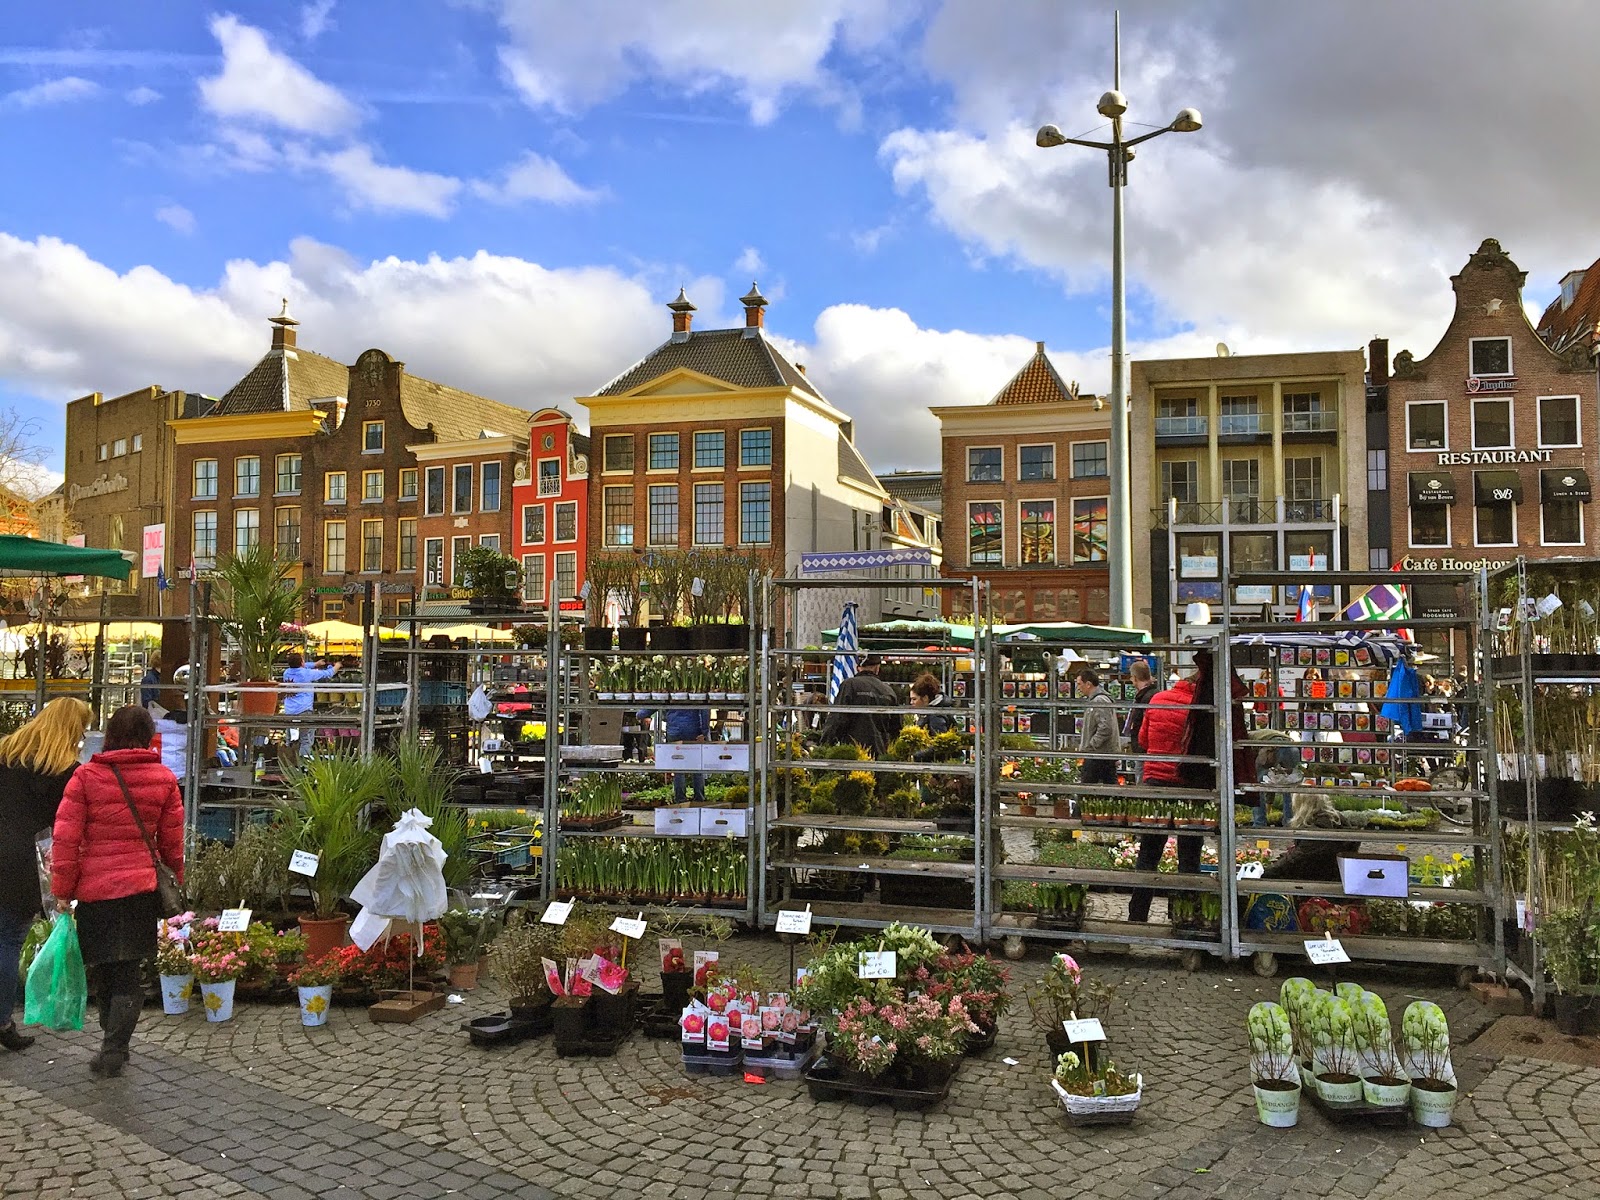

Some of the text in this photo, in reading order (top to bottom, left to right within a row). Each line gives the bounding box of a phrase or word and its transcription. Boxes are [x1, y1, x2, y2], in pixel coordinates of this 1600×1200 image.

[1437, 449, 1553, 466] RESTAURANT
[1403, 558, 1526, 574] Café Hooghou
